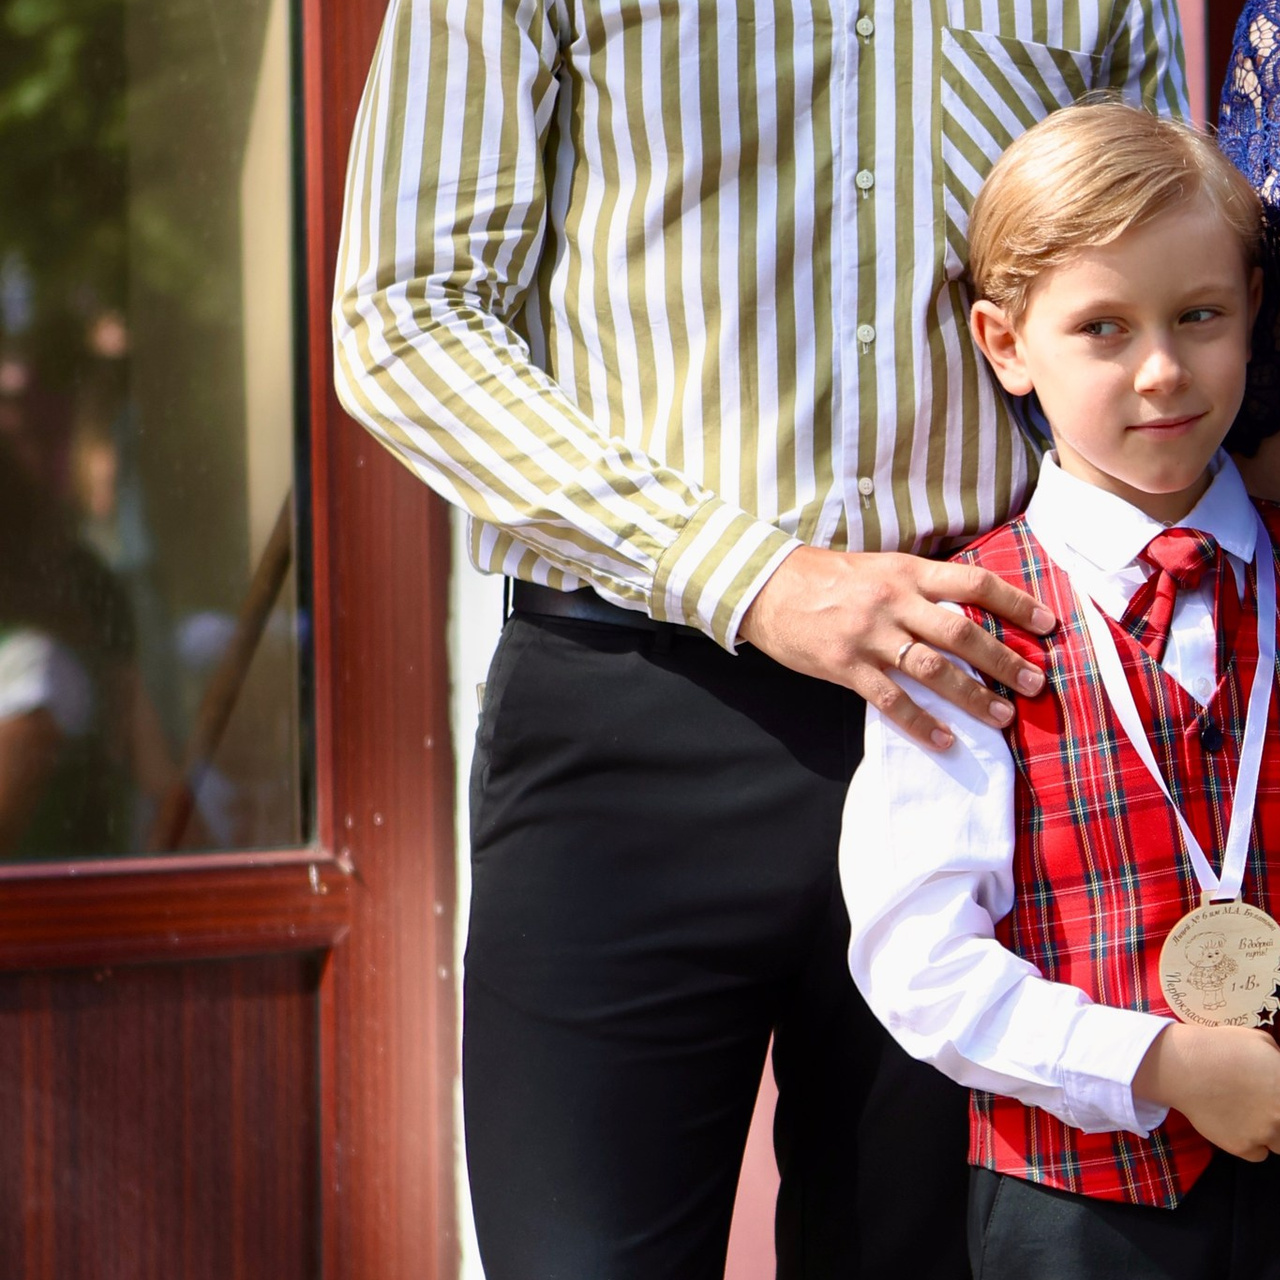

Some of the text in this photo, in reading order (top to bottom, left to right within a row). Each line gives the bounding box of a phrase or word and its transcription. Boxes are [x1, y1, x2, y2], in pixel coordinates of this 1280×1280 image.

[1201, 911, 1208, 920] 6
[1238, 937, 1247, 950] В
[1231, 982, 1236, 992] 1
